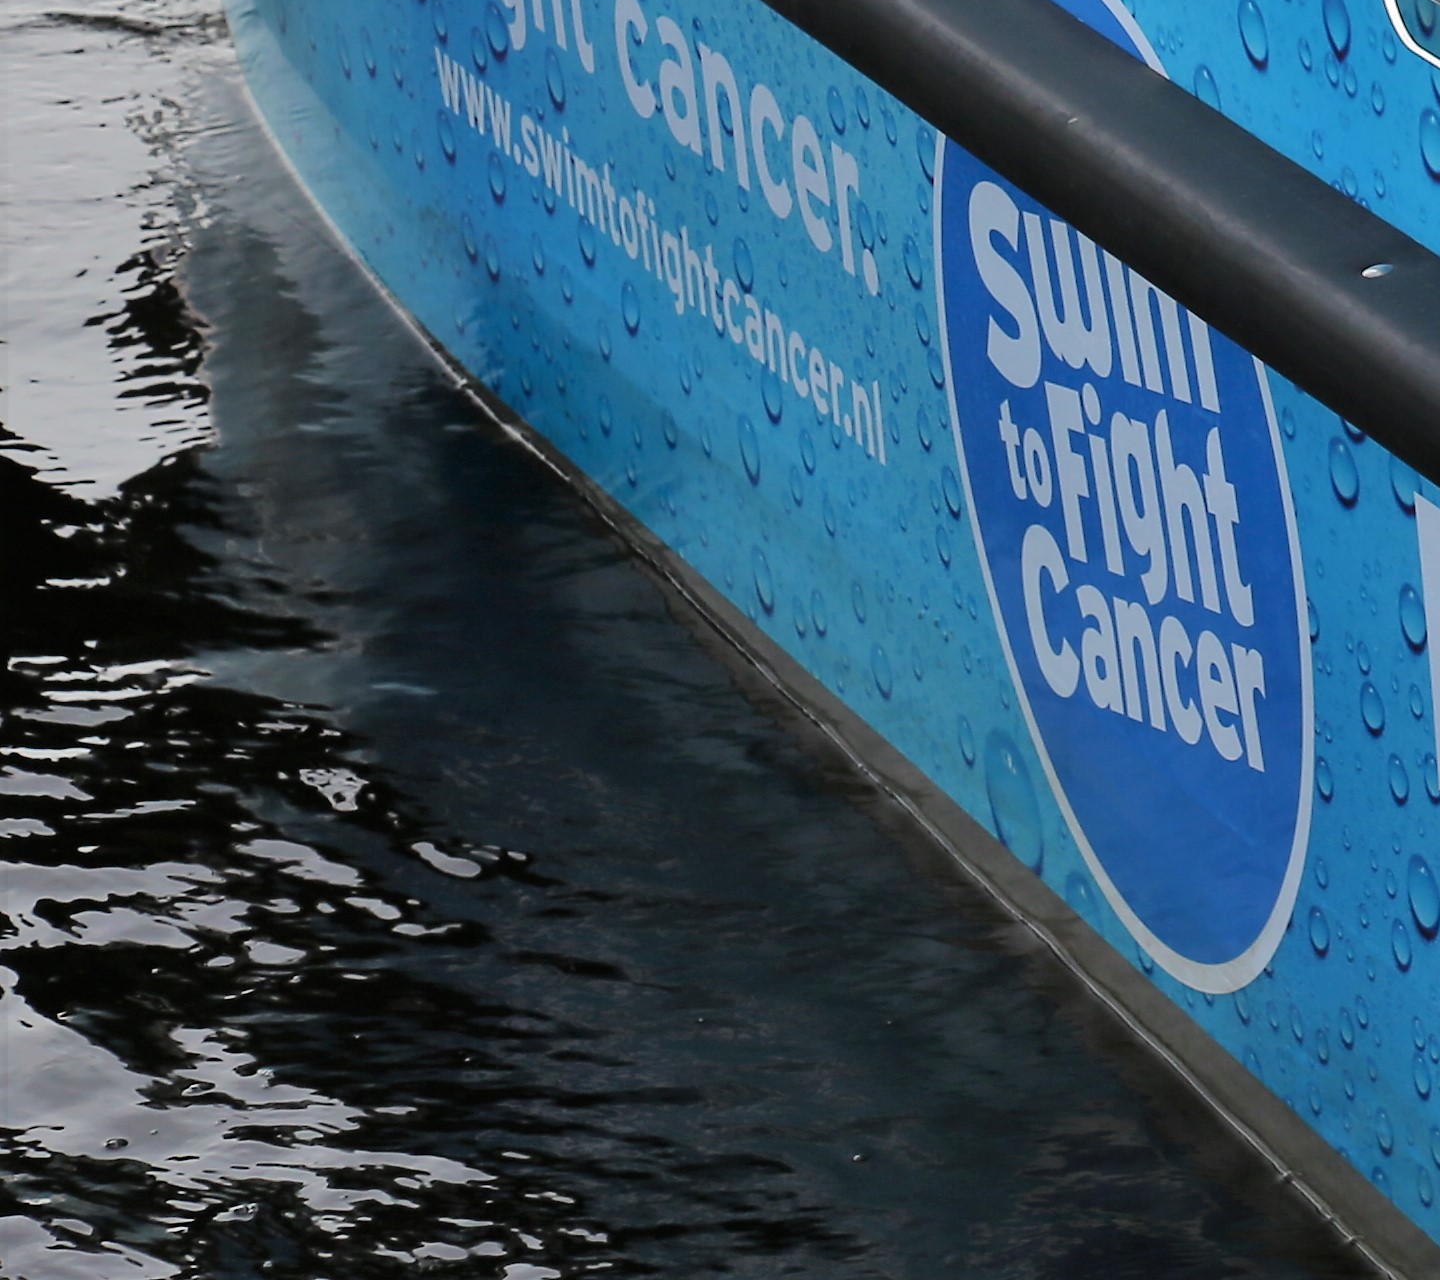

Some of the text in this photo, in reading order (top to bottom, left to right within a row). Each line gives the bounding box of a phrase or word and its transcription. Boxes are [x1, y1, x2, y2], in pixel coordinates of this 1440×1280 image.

[434, 47, 887, 467] www.swimtofightcancer.nl
[999, 380, 1255, 627] to Fight
[1021, 523, 1266, 773] Cancer
